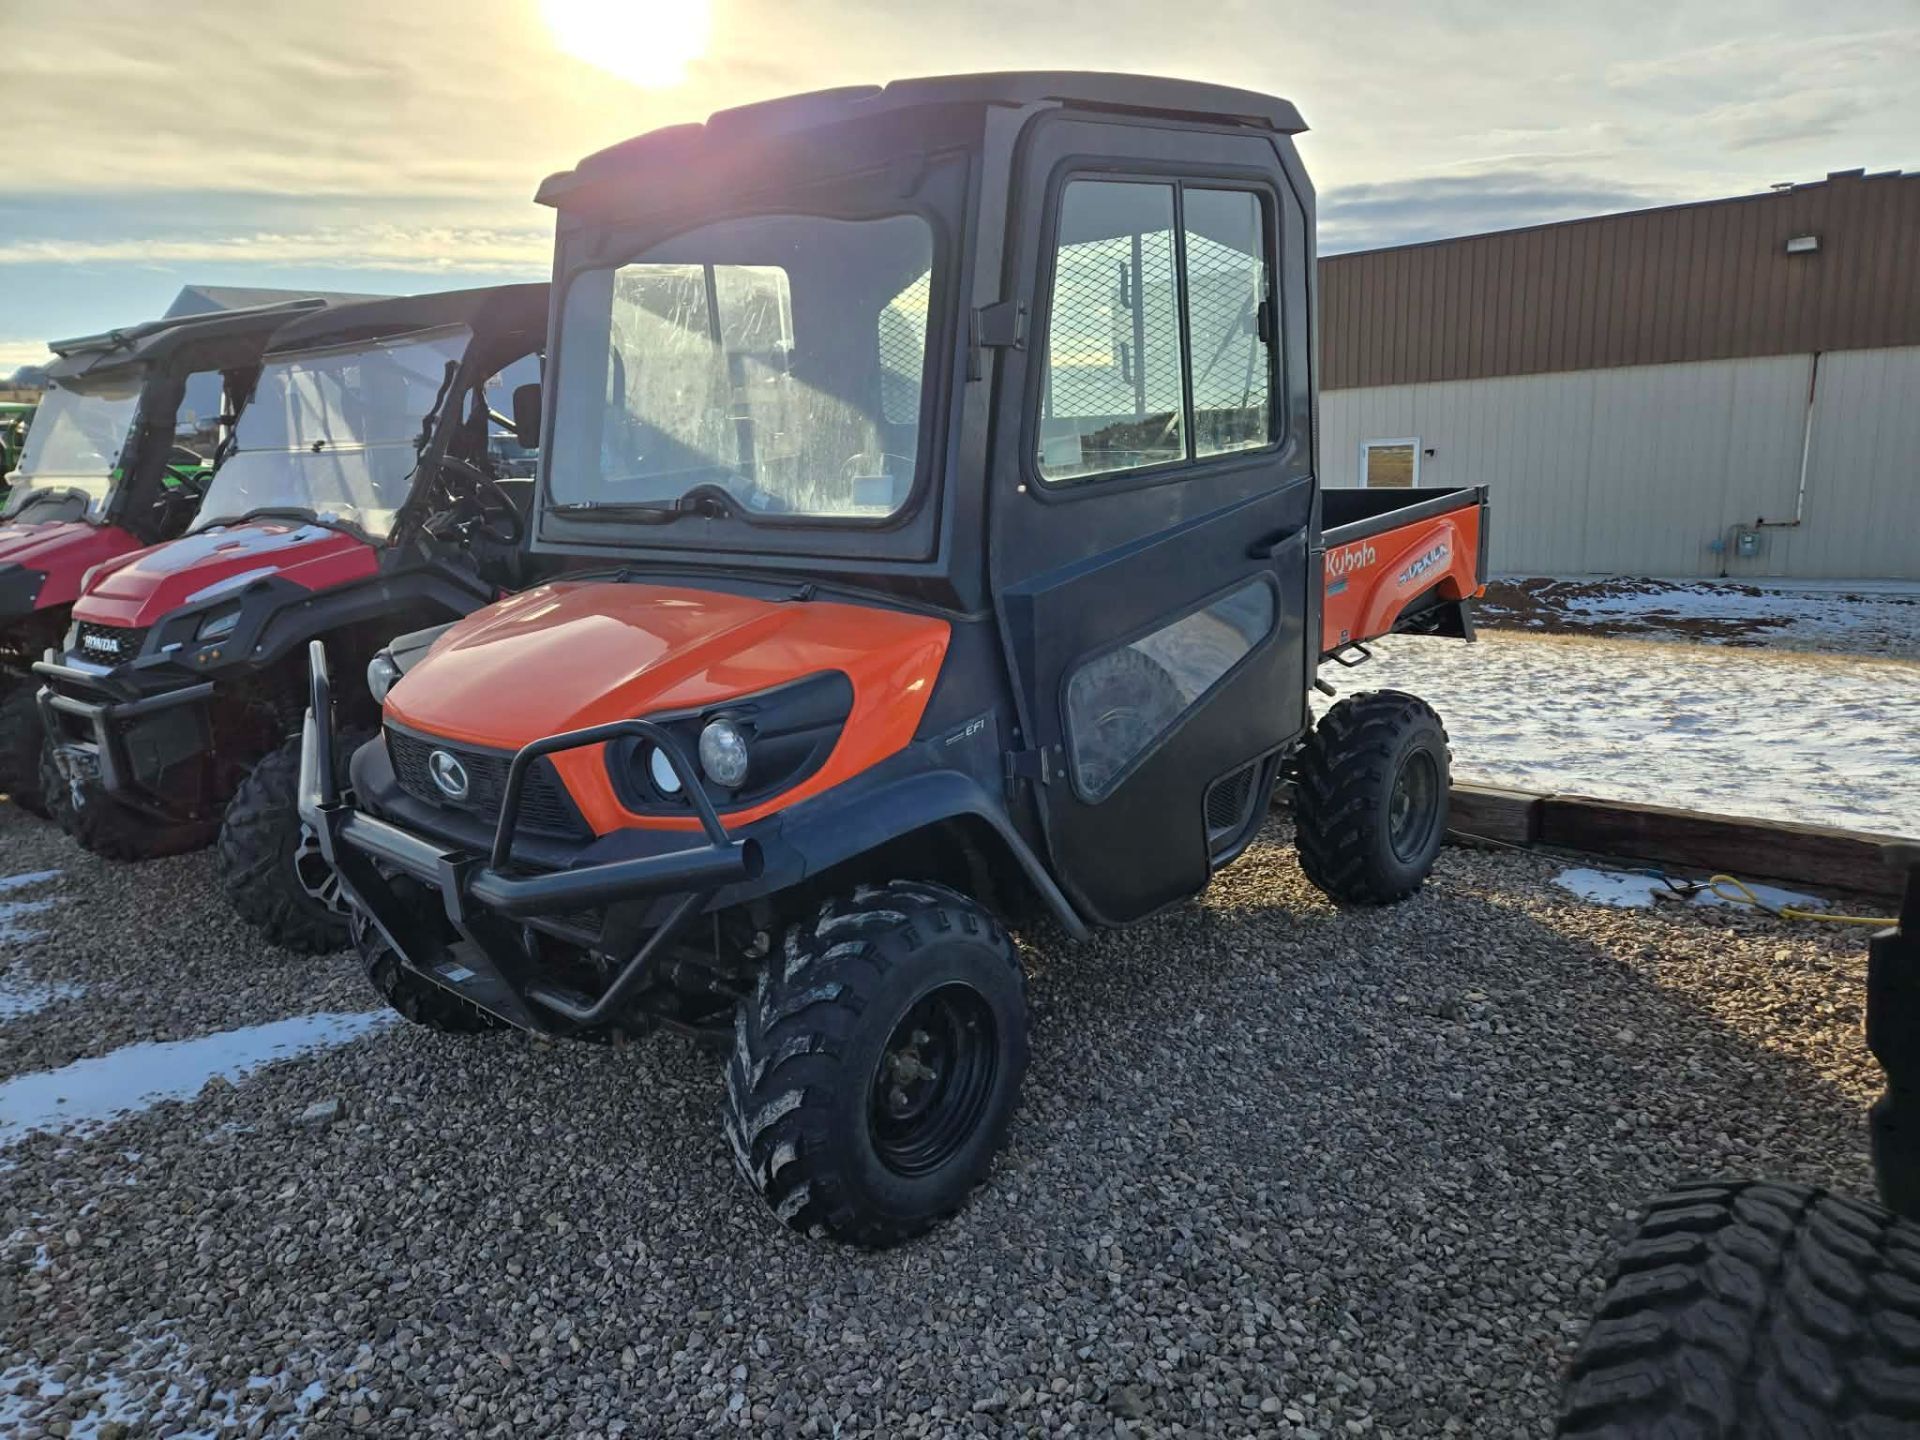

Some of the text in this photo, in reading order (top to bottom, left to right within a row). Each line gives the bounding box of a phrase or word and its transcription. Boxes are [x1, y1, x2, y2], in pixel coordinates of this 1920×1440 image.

[1325, 541, 1376, 576] Kubota
[84, 635, 119, 652] HONDA
[965, 719, 985, 736] EFI
